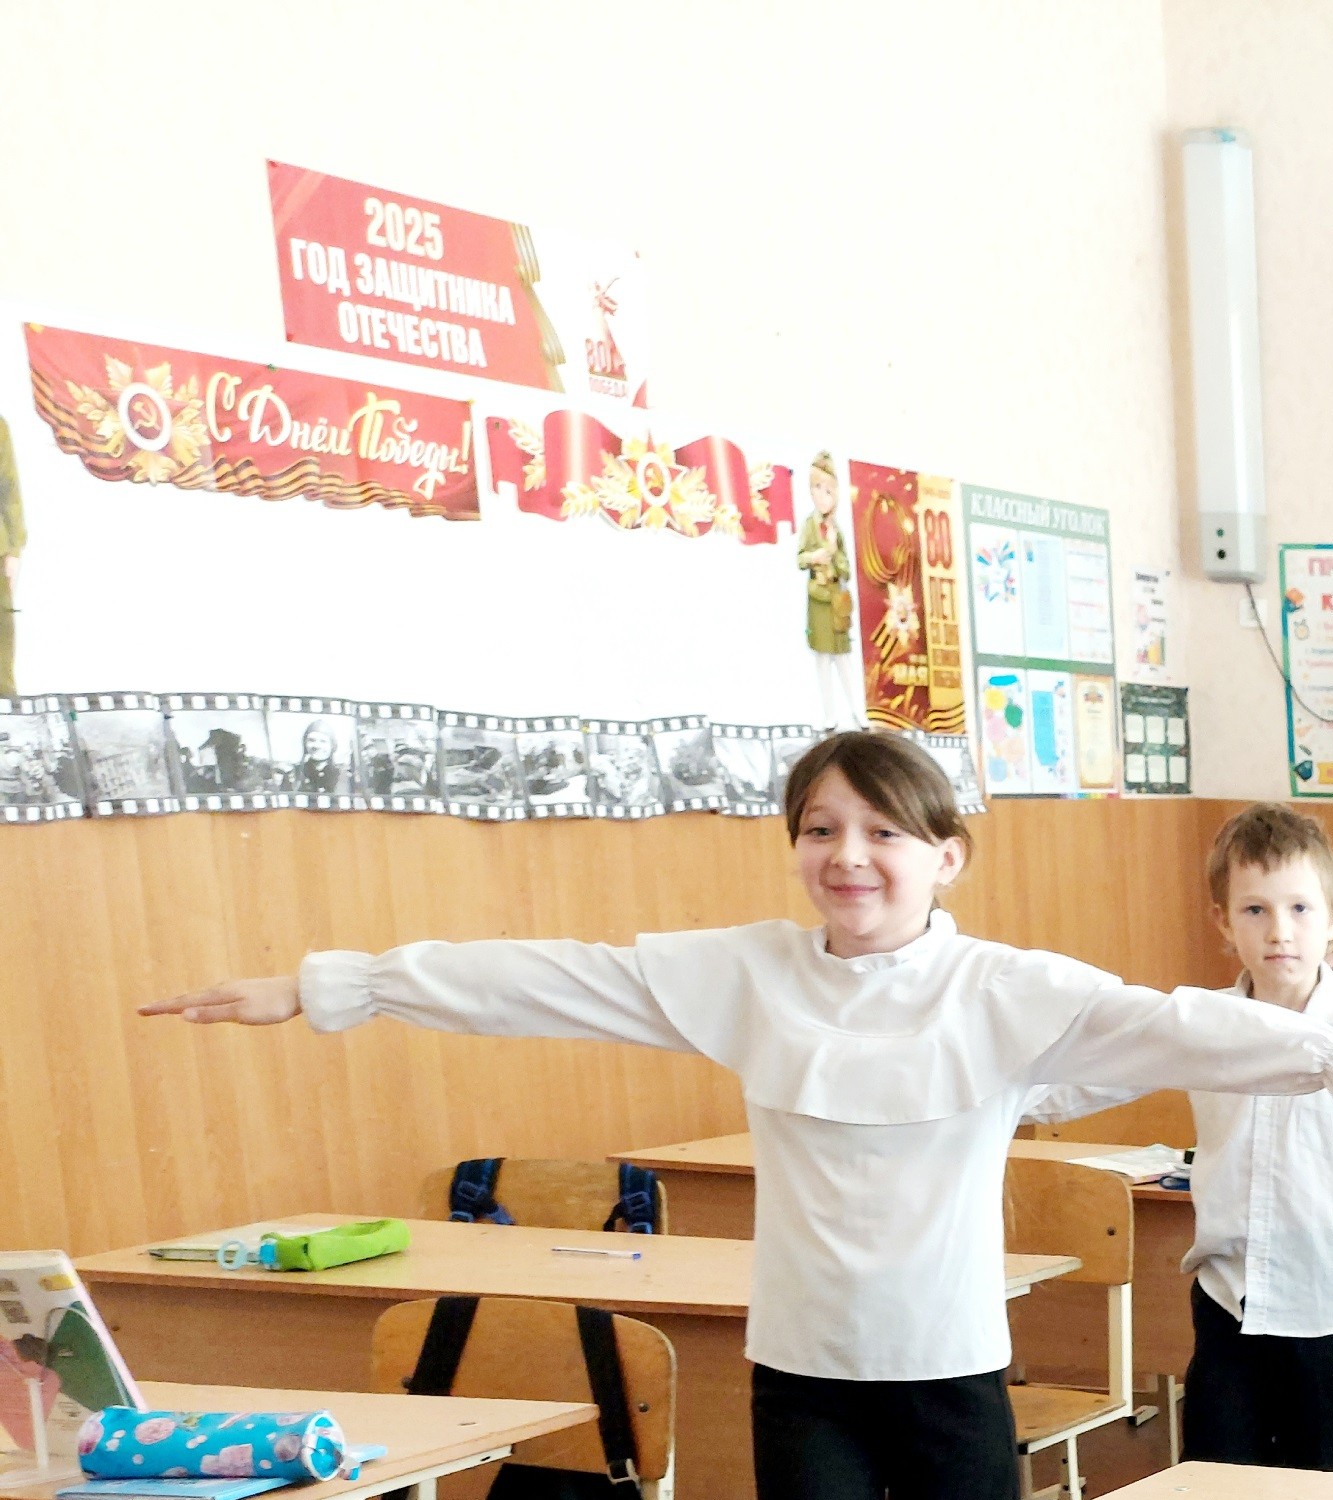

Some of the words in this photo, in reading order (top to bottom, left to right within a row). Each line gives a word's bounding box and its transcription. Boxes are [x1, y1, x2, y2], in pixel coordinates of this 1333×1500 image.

[364, 197, 443, 260] 2025
[290, 238, 350, 297] ГОД
[354, 252, 516, 326] ЗАЩИТНИКА
[337, 301, 487, 368] ОТЕЧЕСТВА
[206, 372, 242, 443] С
[238, 384, 352, 456] Днём
[350, 391, 471, 500] Победы!
[924, 508, 953, 569] 80
[970, 492, 1050, 527] КЛАССНЫЙ
[1052, 508, 1106, 535] УГОЛОК
